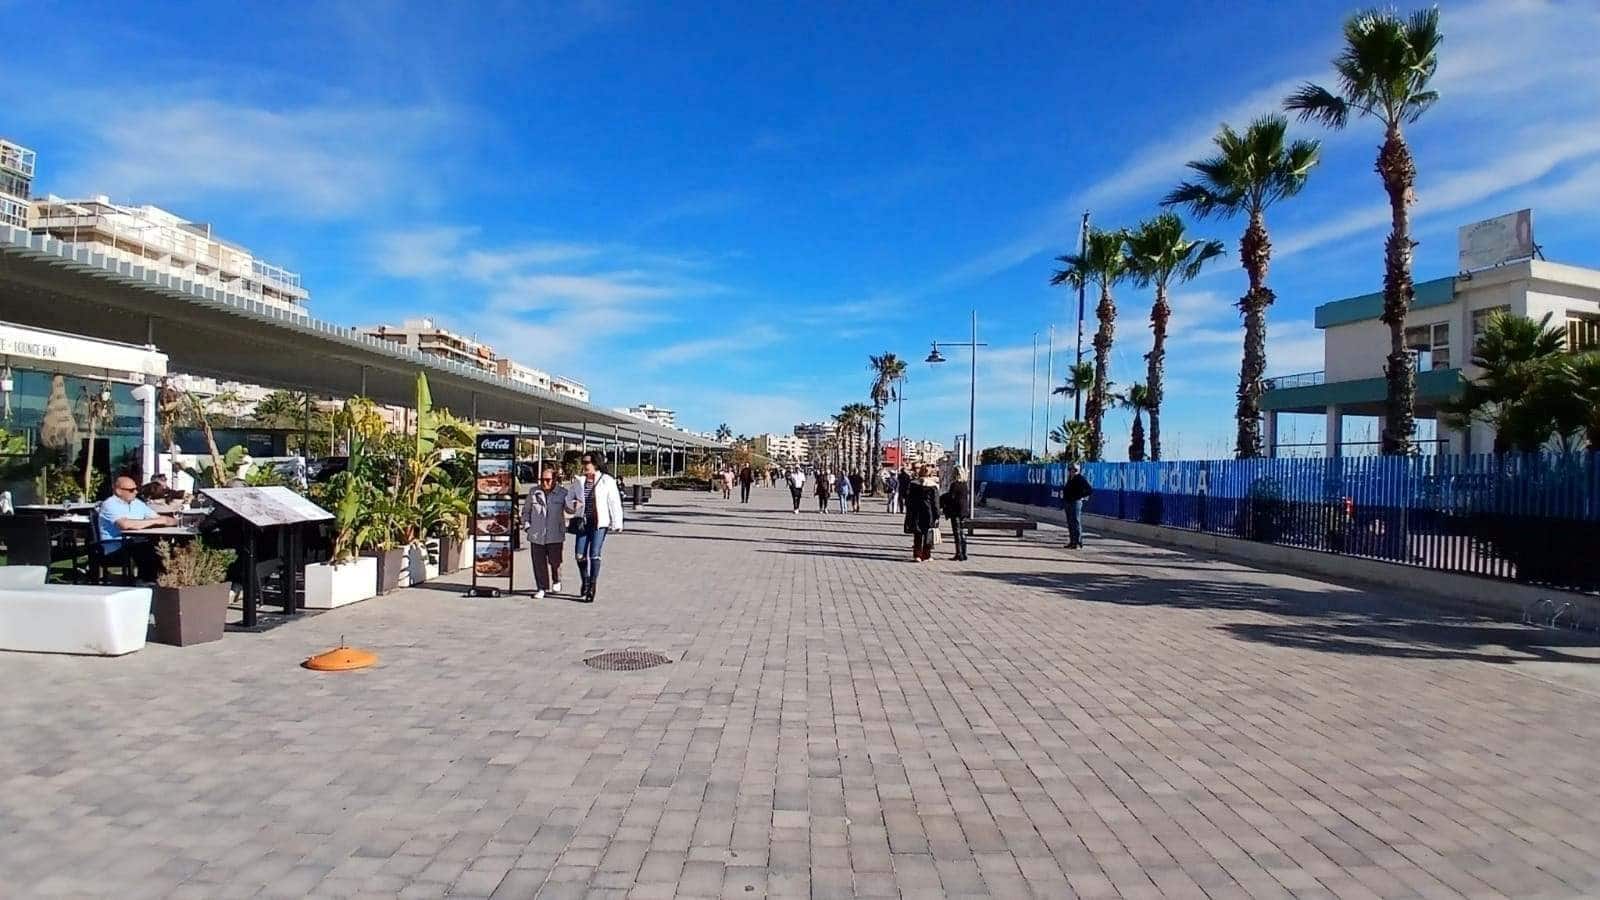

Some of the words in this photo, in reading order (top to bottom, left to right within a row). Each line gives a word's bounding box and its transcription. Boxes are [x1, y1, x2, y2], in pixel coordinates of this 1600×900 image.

[14, 341, 40, 356] LOUNGE
[42, 344, 57, 358] BAR
[1027, 467, 1046, 485] CLUB
[1103, 468, 1147, 492] SANTA
[1159, 469, 1208, 496] POLA
